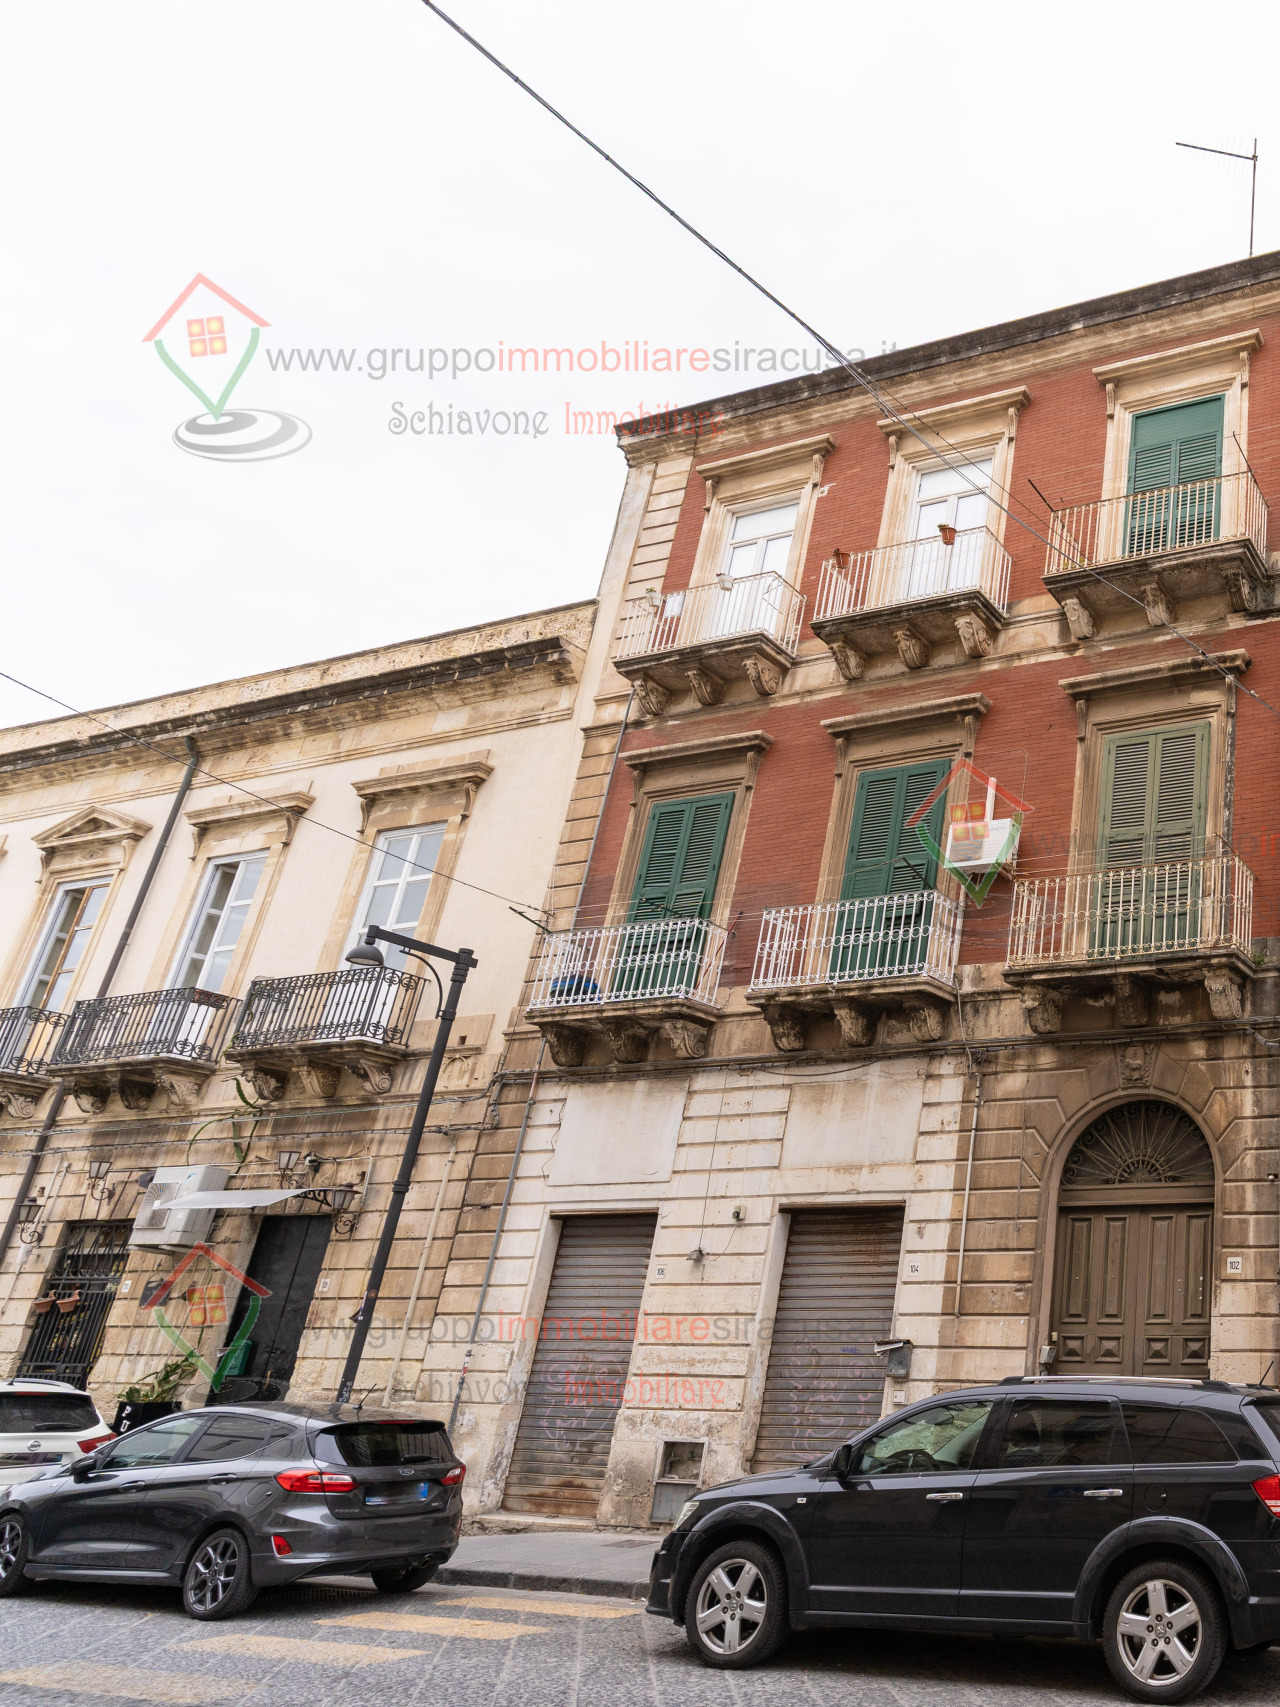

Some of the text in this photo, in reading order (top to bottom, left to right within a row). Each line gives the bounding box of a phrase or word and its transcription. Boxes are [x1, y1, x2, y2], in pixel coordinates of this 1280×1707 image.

[910, 1264, 920, 1274] 104
[1229, 1260, 1240, 1270] 102
[656, 1267, 666, 1277] 106
